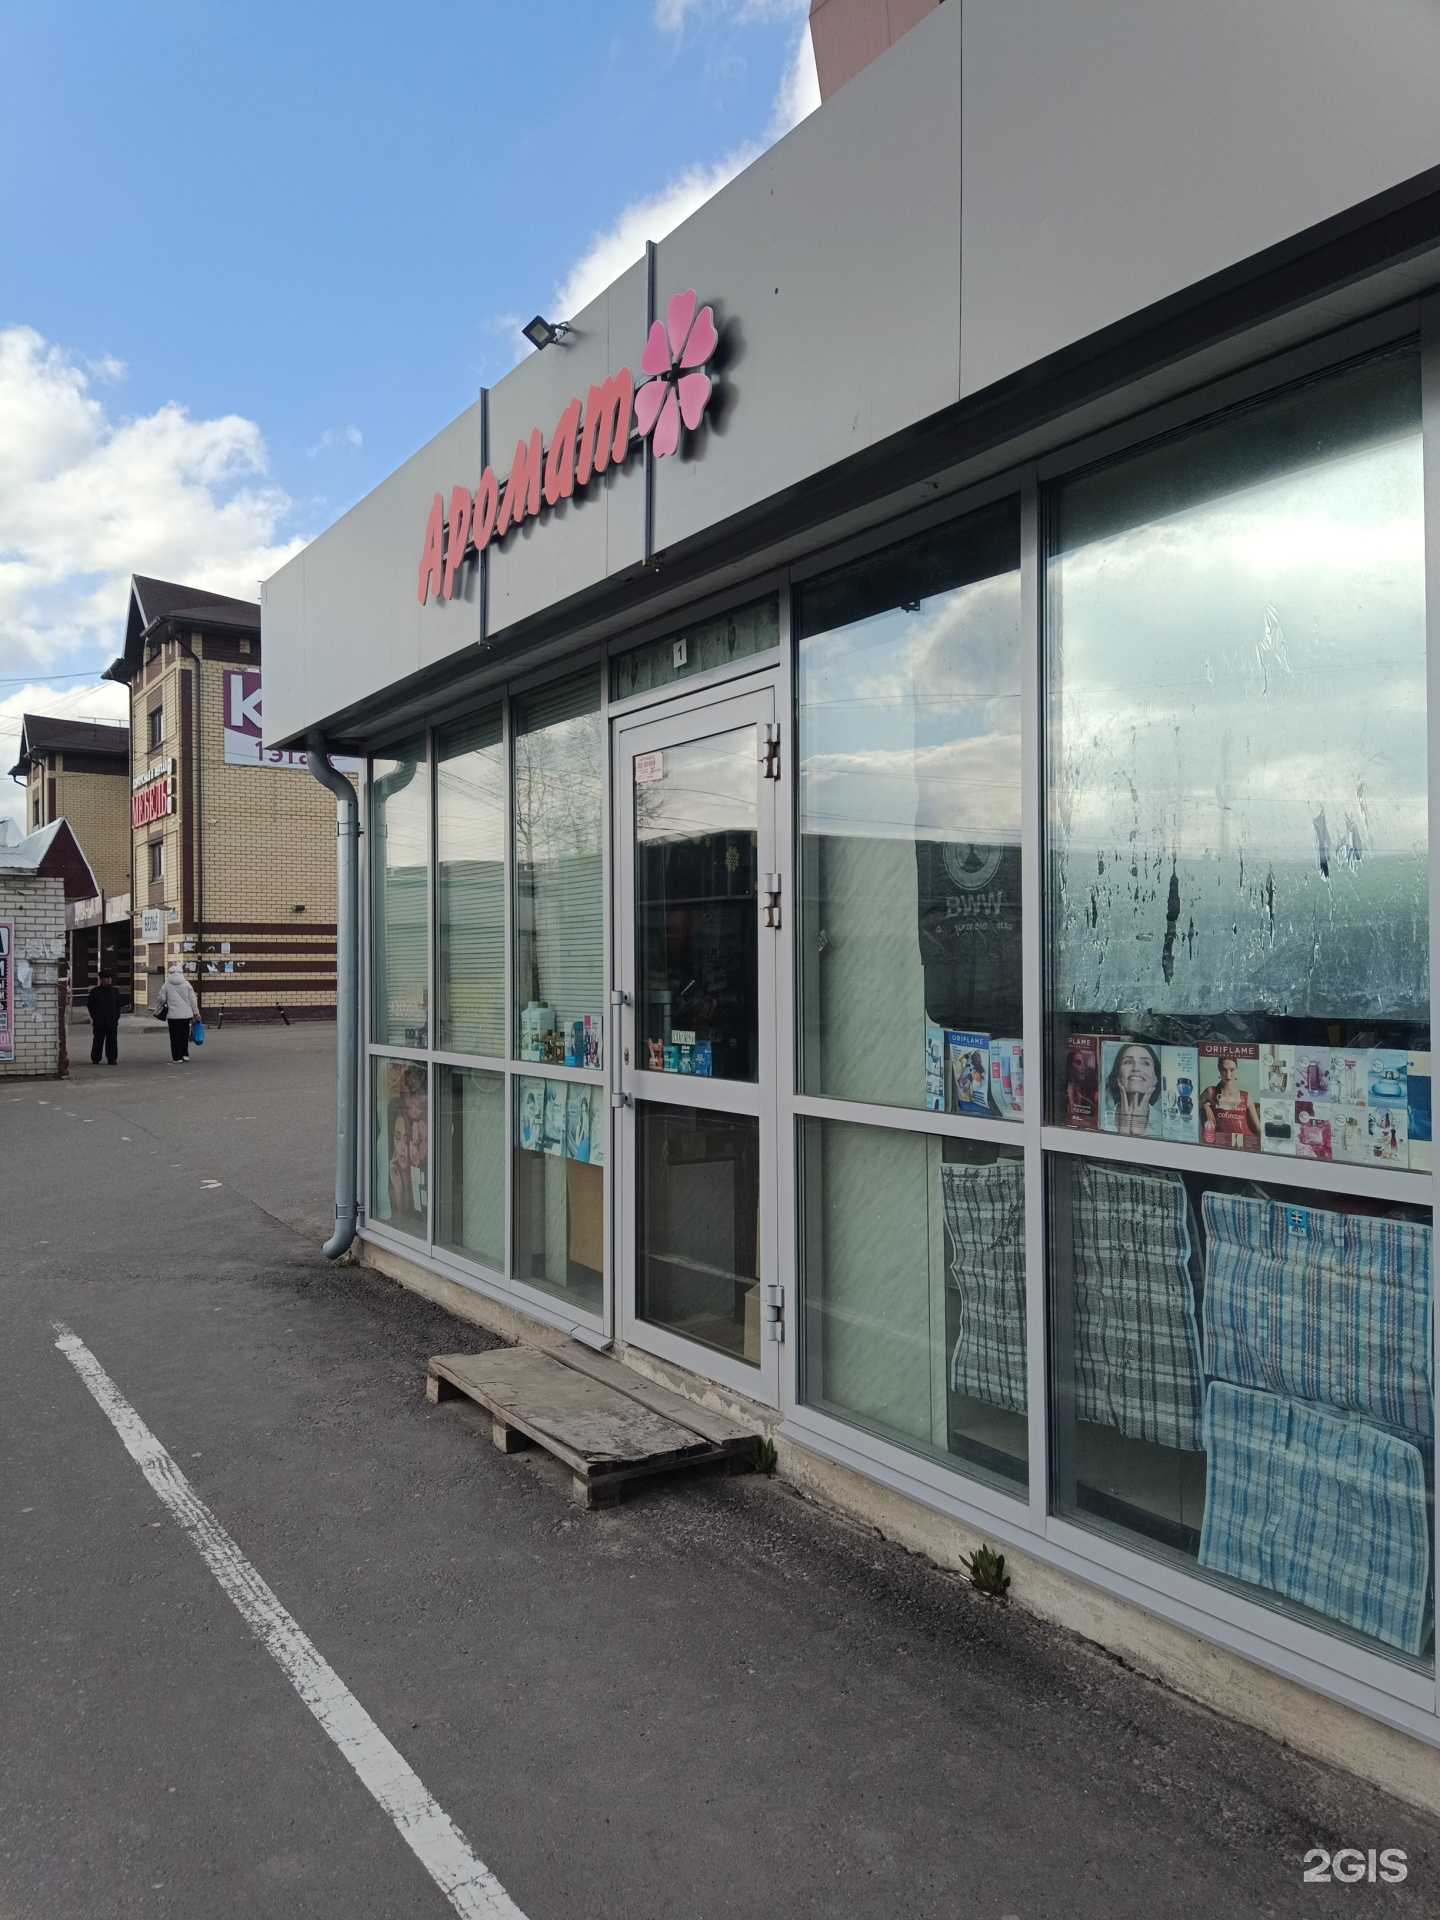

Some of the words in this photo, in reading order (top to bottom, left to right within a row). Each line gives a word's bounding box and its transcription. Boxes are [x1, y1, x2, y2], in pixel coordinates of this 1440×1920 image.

[132, 780, 168, 828] МЕБЕЛЬ
[951, 1035, 983, 1045] ORIFLAME
[1205, 1045, 1255, 1055] ORIFLAME
